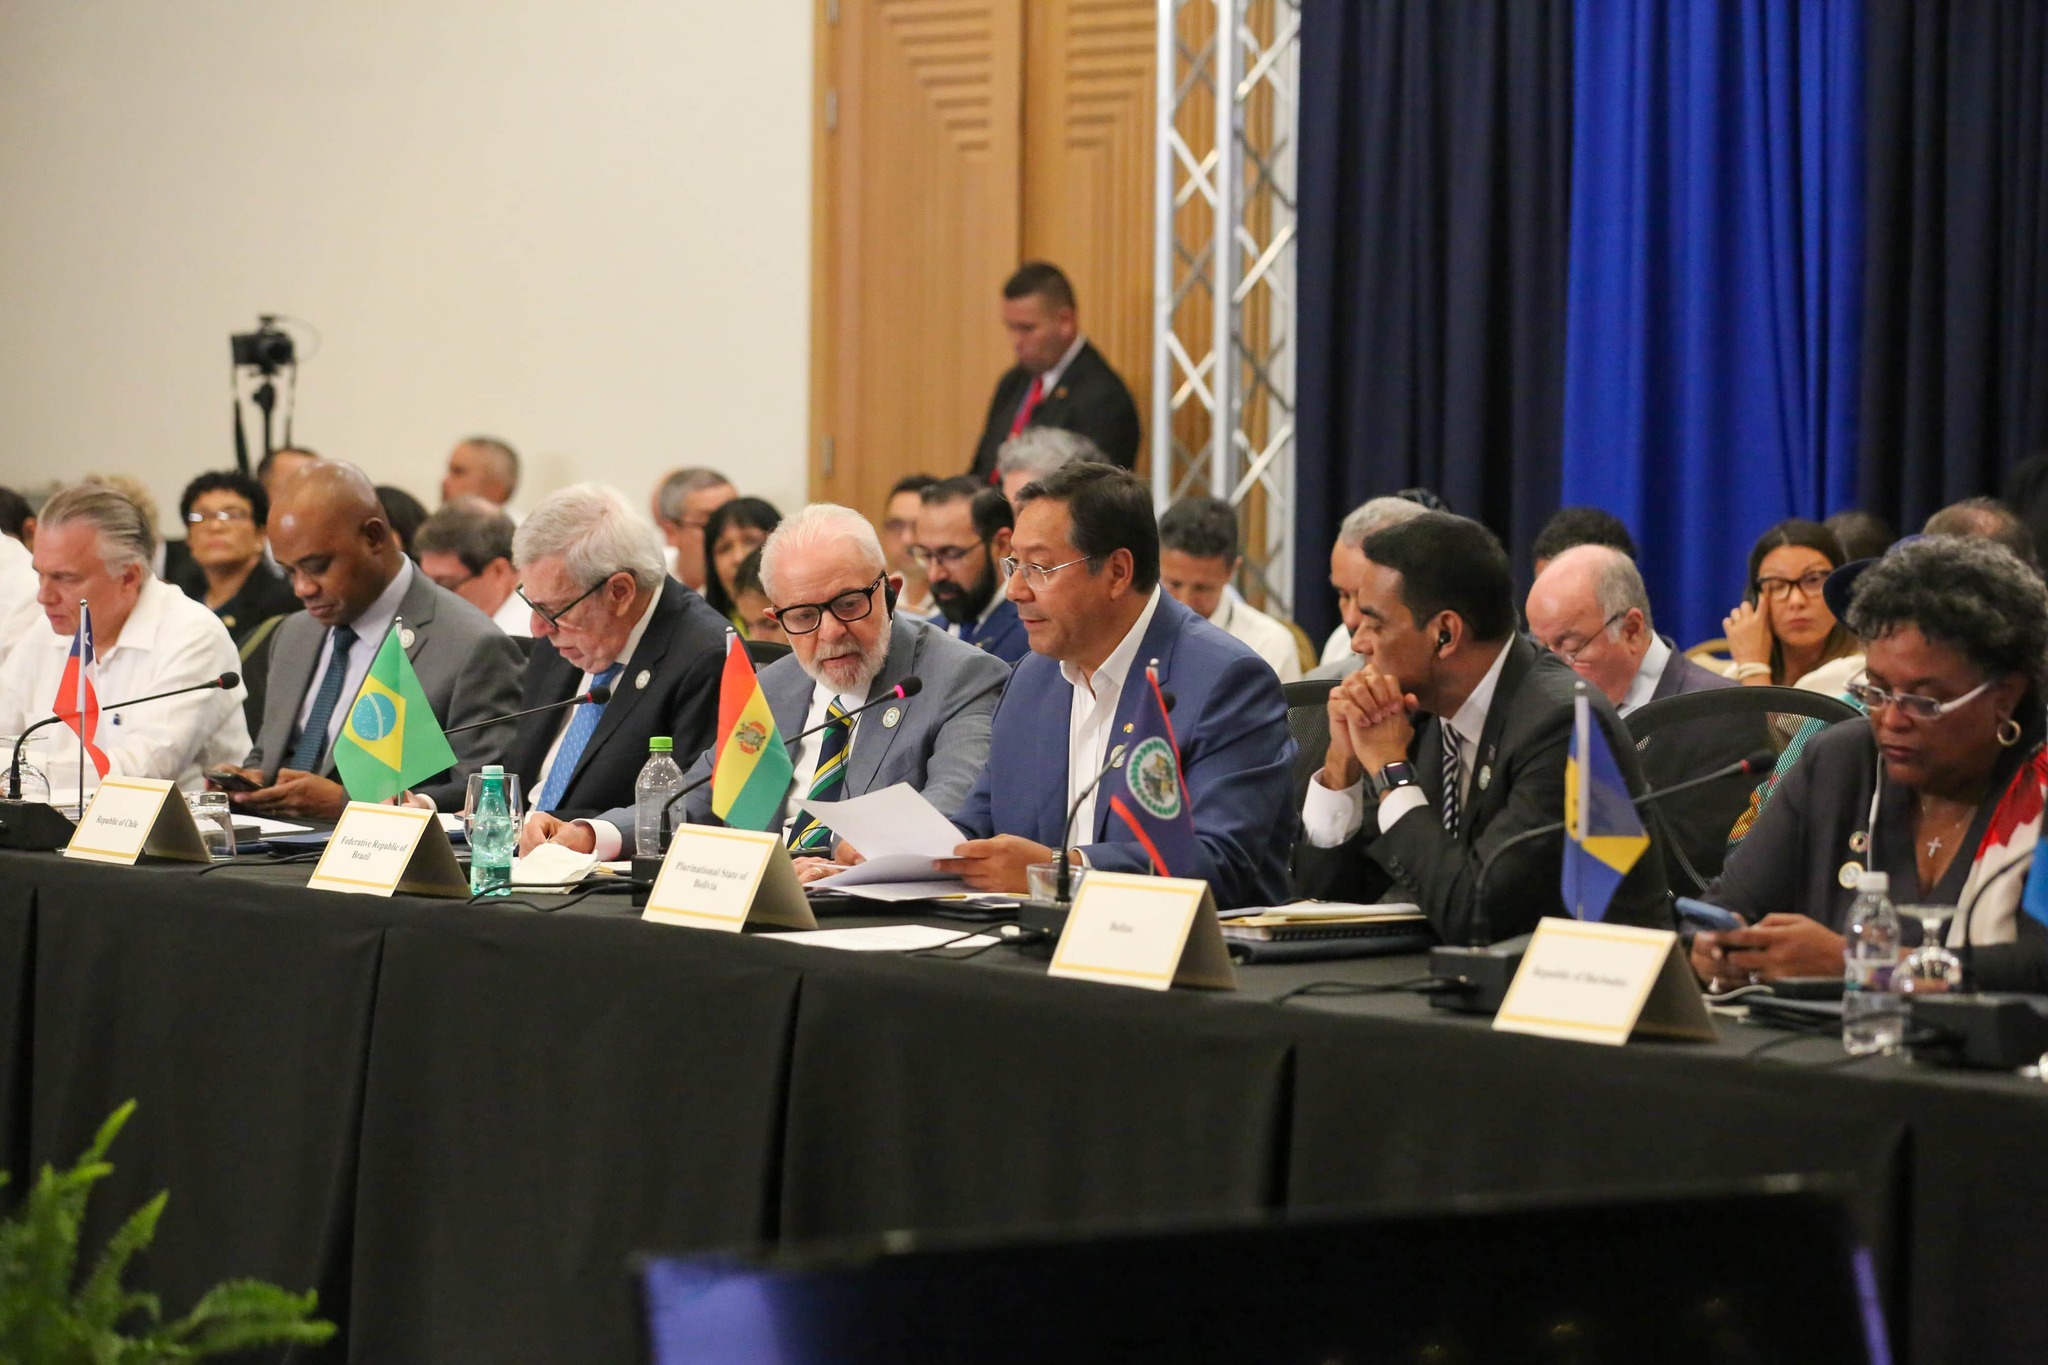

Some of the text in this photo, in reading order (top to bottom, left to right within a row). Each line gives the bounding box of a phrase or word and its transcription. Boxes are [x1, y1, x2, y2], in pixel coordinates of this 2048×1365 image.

[96, 815, 138, 828] Republic of Chile
[341, 836, 408, 852] Federative Republic of
[351, 850, 371, 861] Brazil
[675, 861, 749, 881] Plurinational State of
[693, 879, 717, 891] Bolivia
